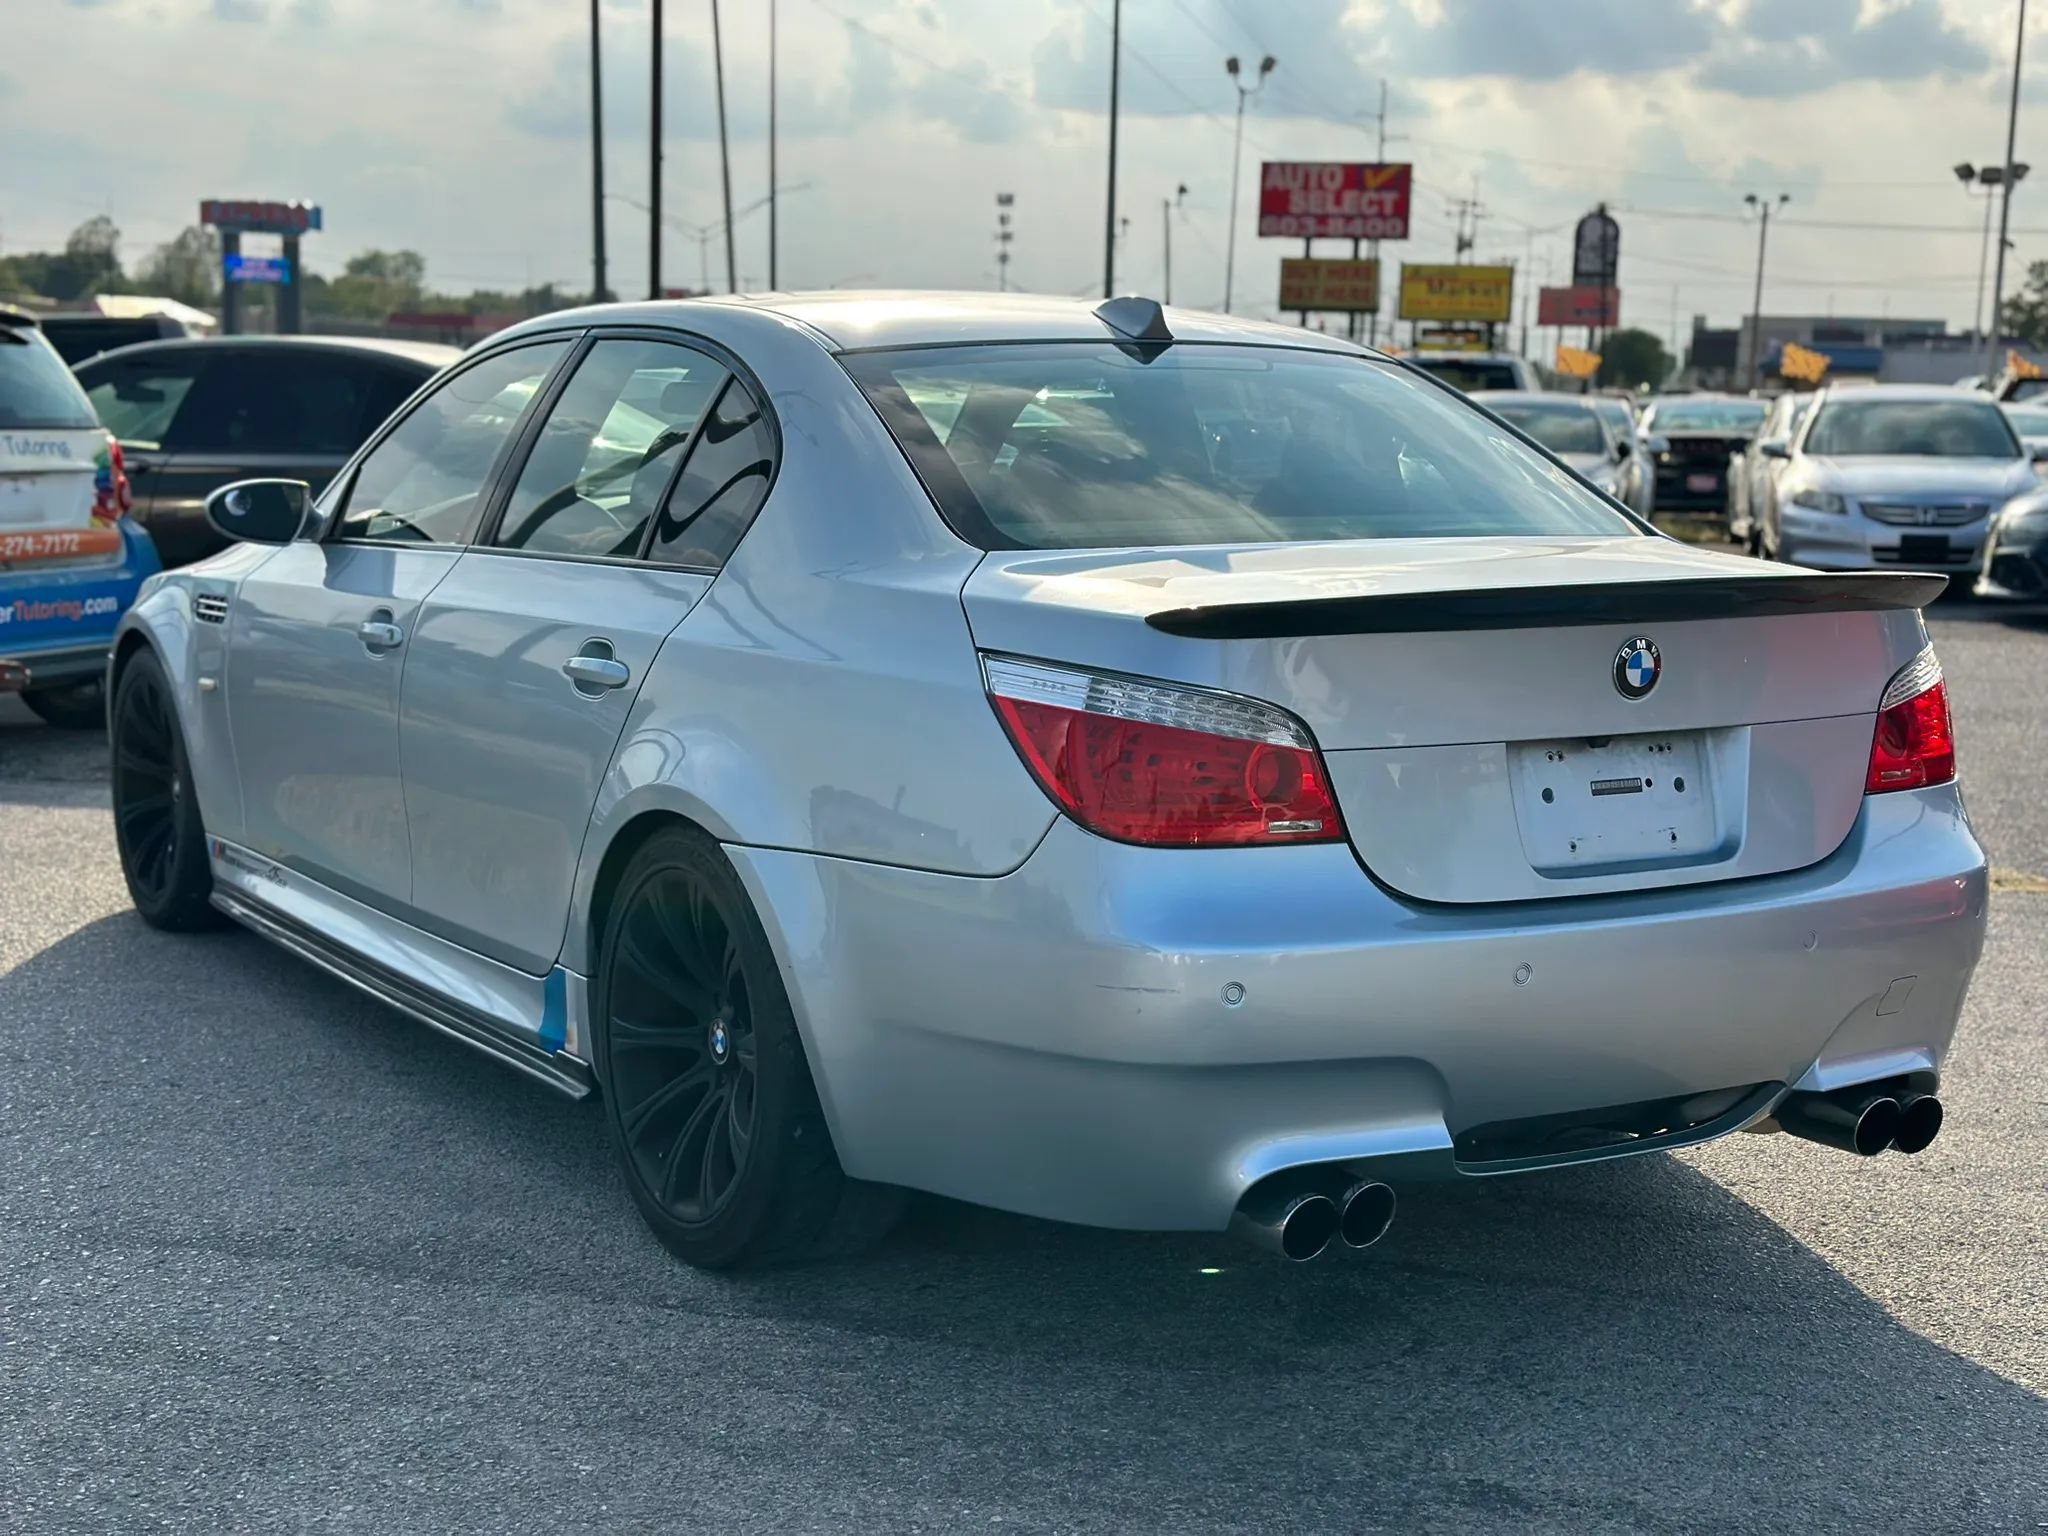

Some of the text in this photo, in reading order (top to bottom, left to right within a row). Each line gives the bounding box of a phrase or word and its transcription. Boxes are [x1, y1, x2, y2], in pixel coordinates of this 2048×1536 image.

[1265, 165, 1344, 191] AUTO
[1289, 189, 1399, 216] SELECT
[3, 435, 72, 460] Tutoring
[1621, 639, 1659, 660] BMW
